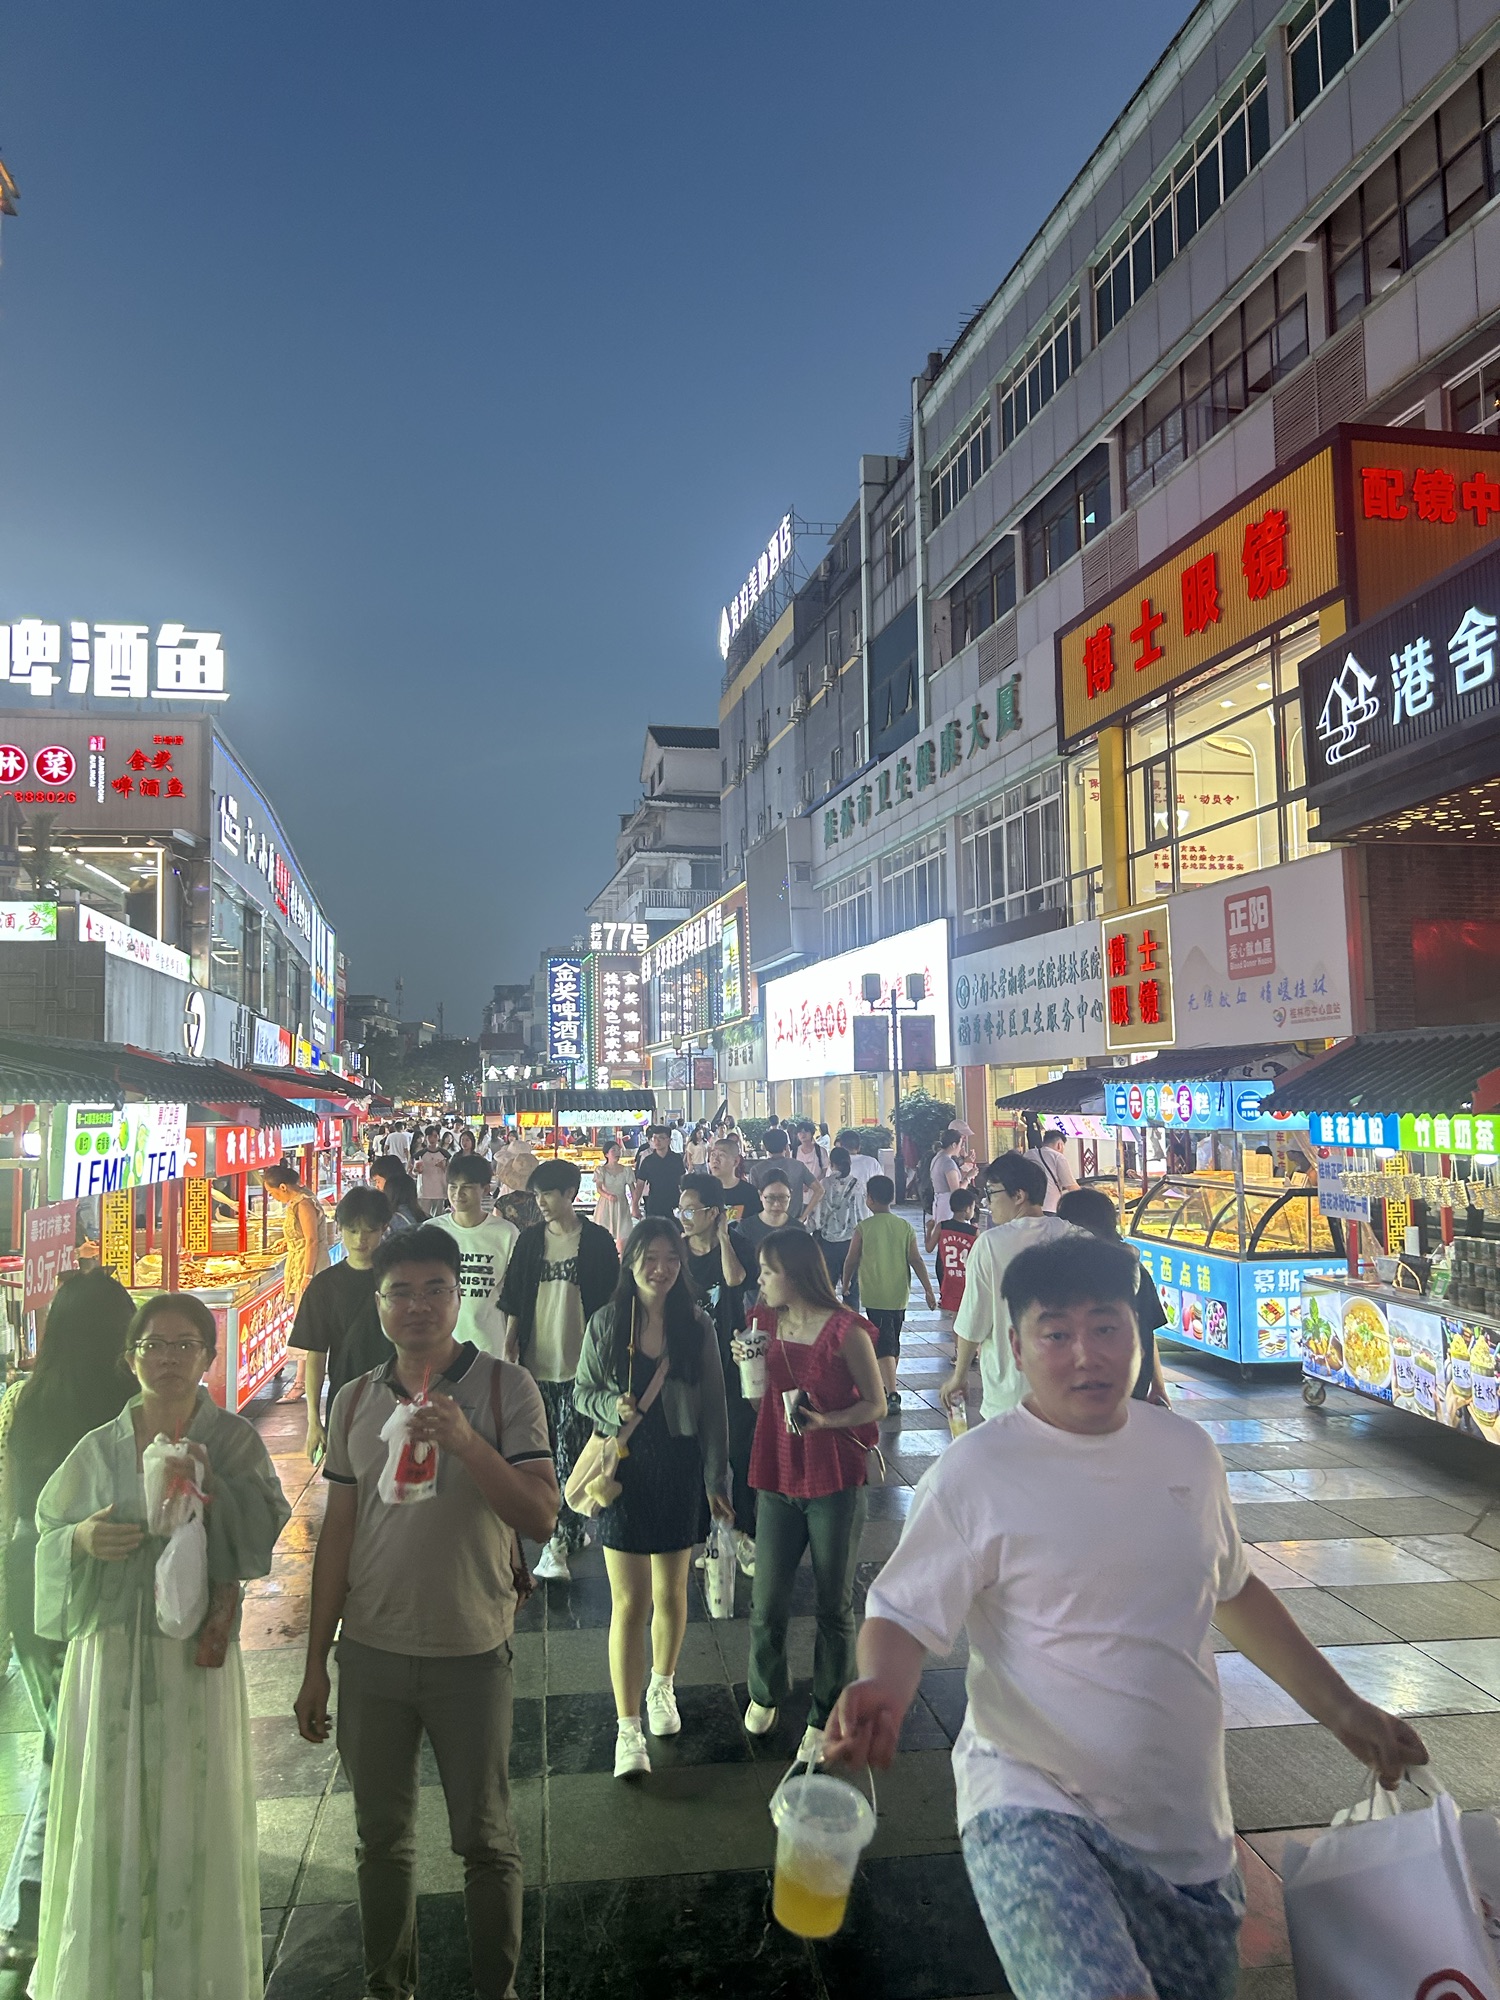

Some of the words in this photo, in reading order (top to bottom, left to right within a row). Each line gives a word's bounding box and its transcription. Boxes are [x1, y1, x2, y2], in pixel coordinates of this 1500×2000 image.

[1361, 466, 1500, 527] 配镜中
[1083, 508, 1290, 700] 博士眼镜
[0, 619, 230, 701] 啤酒鱼
[1390, 606, 1499, 725] 港舍
[126, 749, 173, 772] 金奖
[823, 673, 1022, 850] 桂林市卫生健康大厦
[5, 791, 76, 803] 888026
[111, 774, 186, 800] 啤酒鱼
[602, 922, 650, 951] 77号
[1228, 894, 1270, 937] 正阳
[1107, 929, 1158, 978] 博士
[1228, 937, 1272, 961] 爱心献血屋
[1229, 961, 1243, 971] Blood
[1244, 960, 1258, 969] Donor
[1258, 957, 1273, 966] House
[971, 945, 1102, 1006] 中南大学湘雅二医院桂林医院
[551, 961, 581, 1060] 金奖啤酒鱼
[602, 972, 621, 1064] 桂林特色农家菜
[621, 972, 641, 1063] 金奖啤酒鱼
[1109, 977, 1161, 1028] 眼镜
[1289, 1002, 1341, 1019] 桂林市中心血站
[1320, 1115, 1384, 1145] 桂花冰粉
[1414, 1119, 1495, 1151] 竹筒奶茶
[30, 1213, 71, 1242] 暴打柠檬茶
[26, 1244, 74, 1297] 9.9元/杯
[470, 1288, 492, 1298] MY
